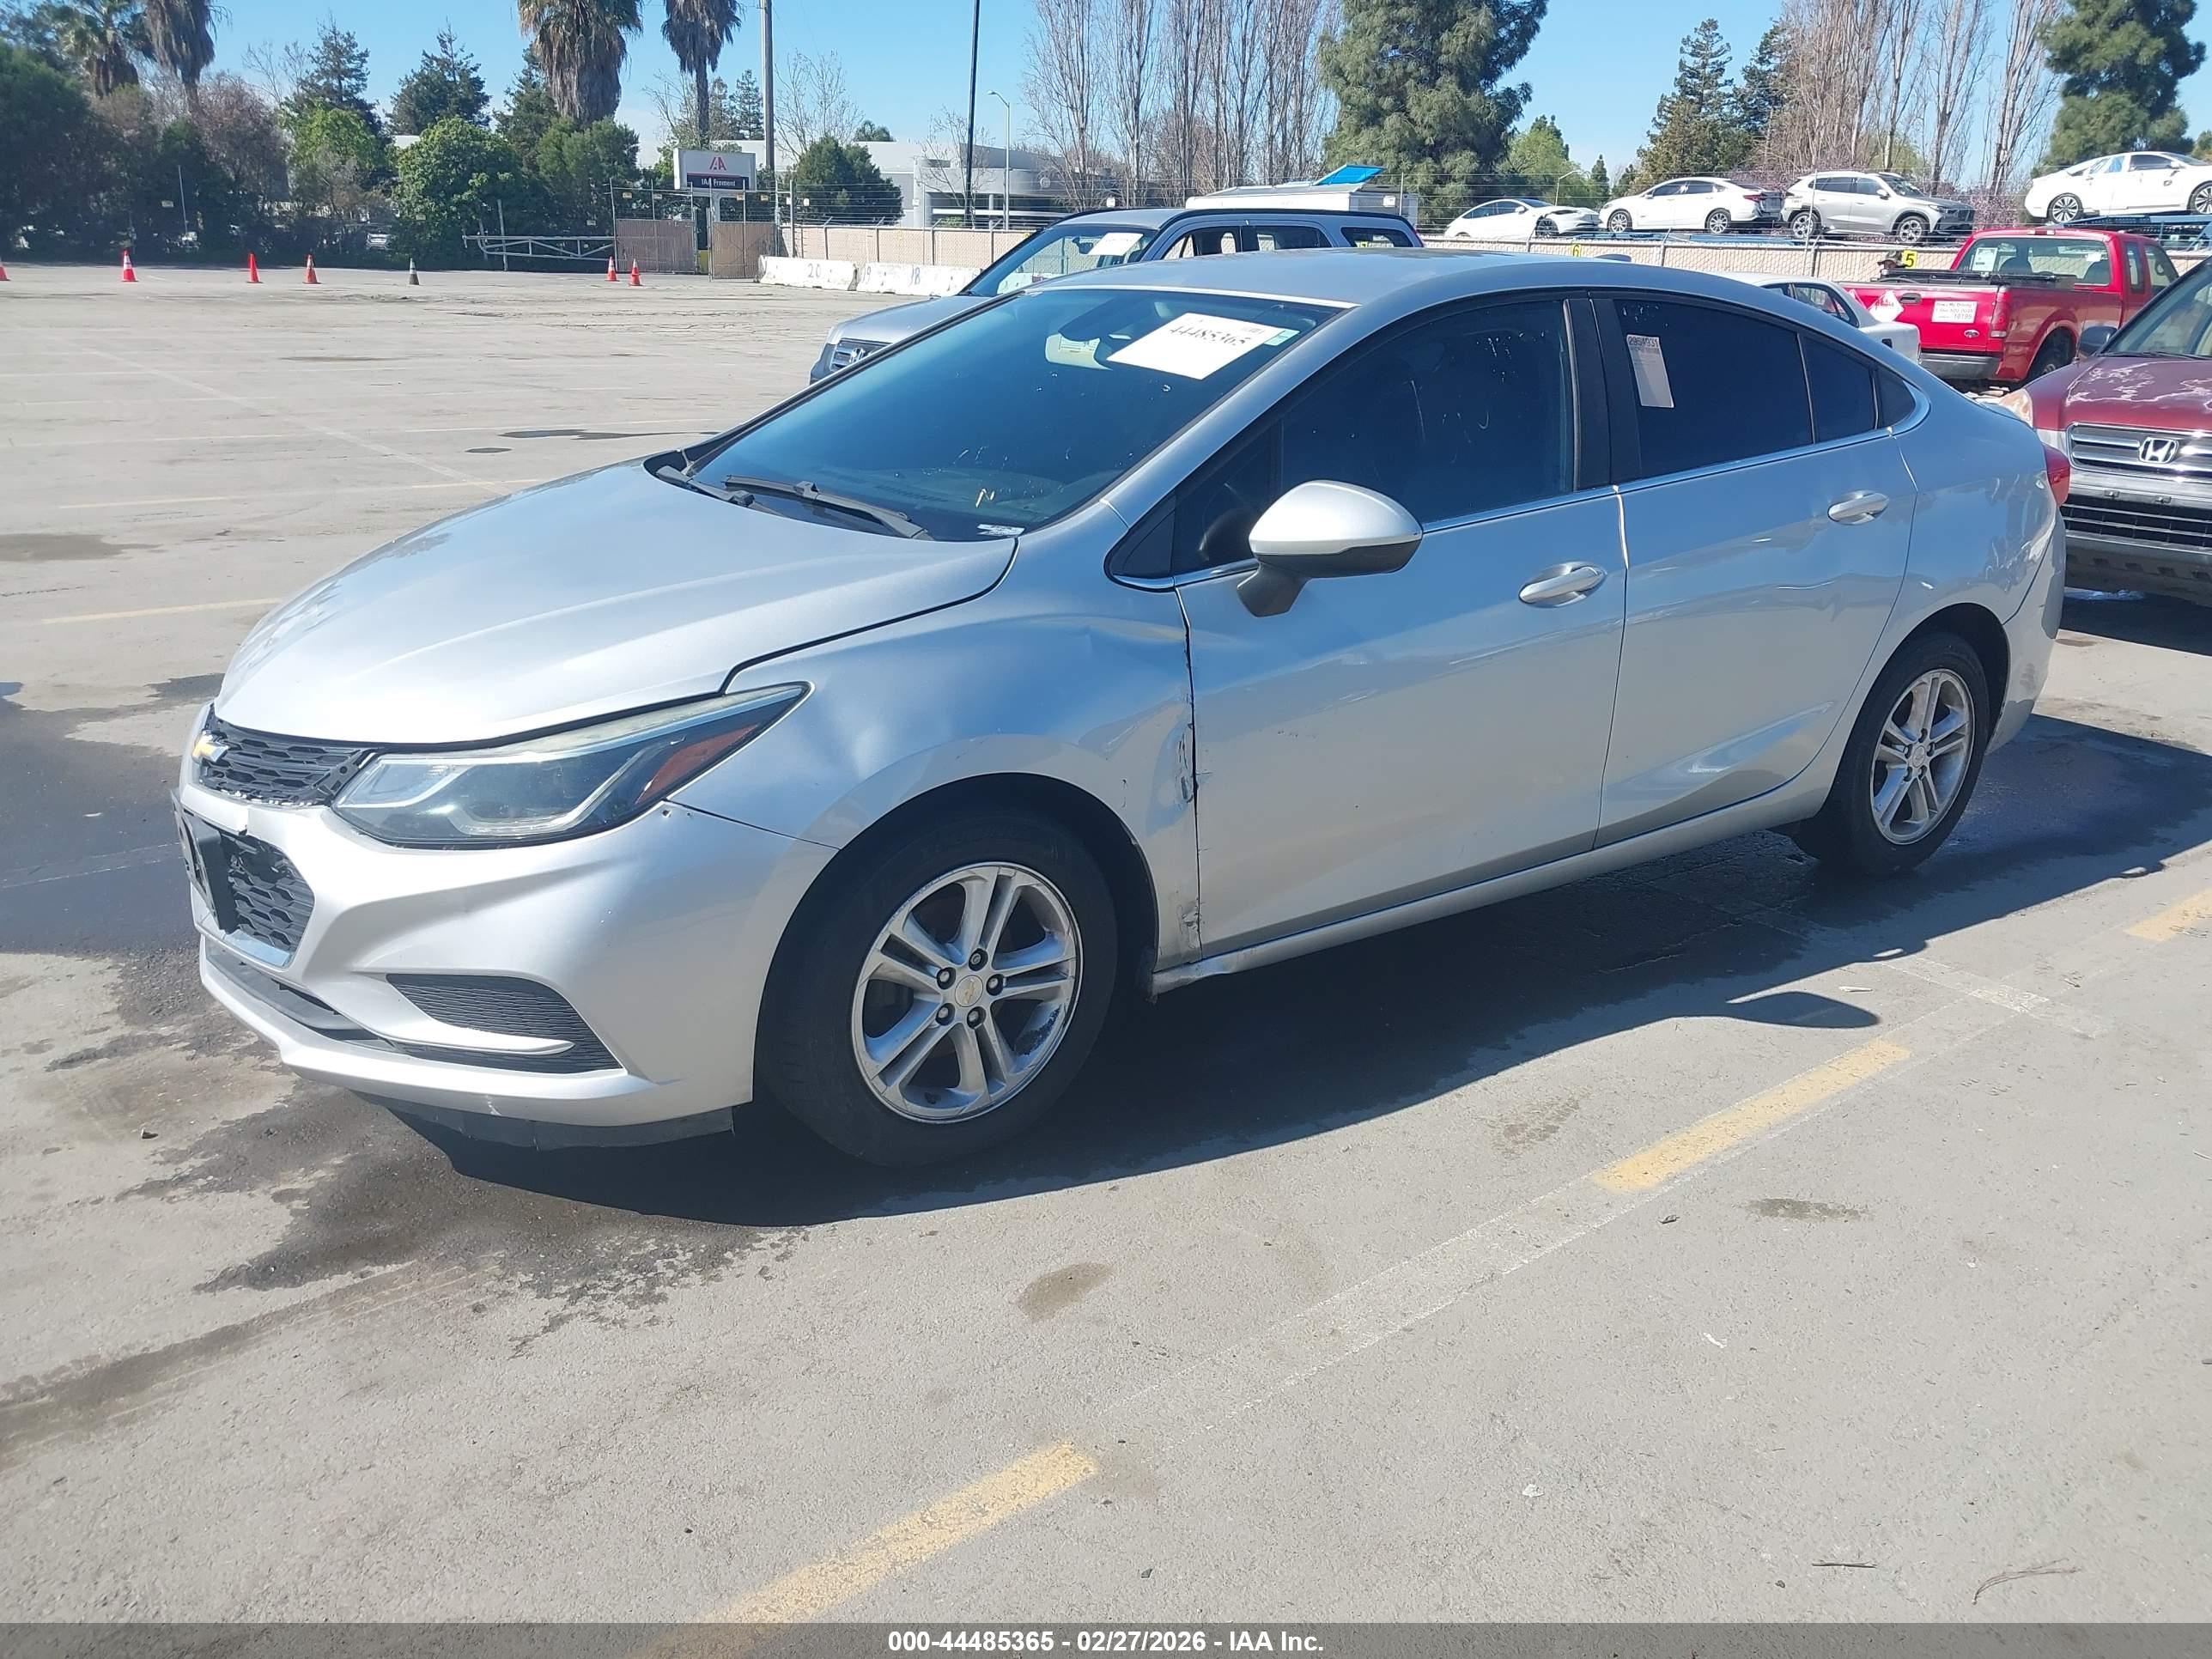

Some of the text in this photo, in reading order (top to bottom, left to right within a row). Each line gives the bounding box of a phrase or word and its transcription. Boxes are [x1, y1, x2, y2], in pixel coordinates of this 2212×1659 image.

[713, 179, 736, 187] Fremont
[1905, 253, 1915, 268] 5
[807, 263, 821, 278] 20
[909, 266, 921, 286] 18
[1170, 325, 1252, 346] 44485365
